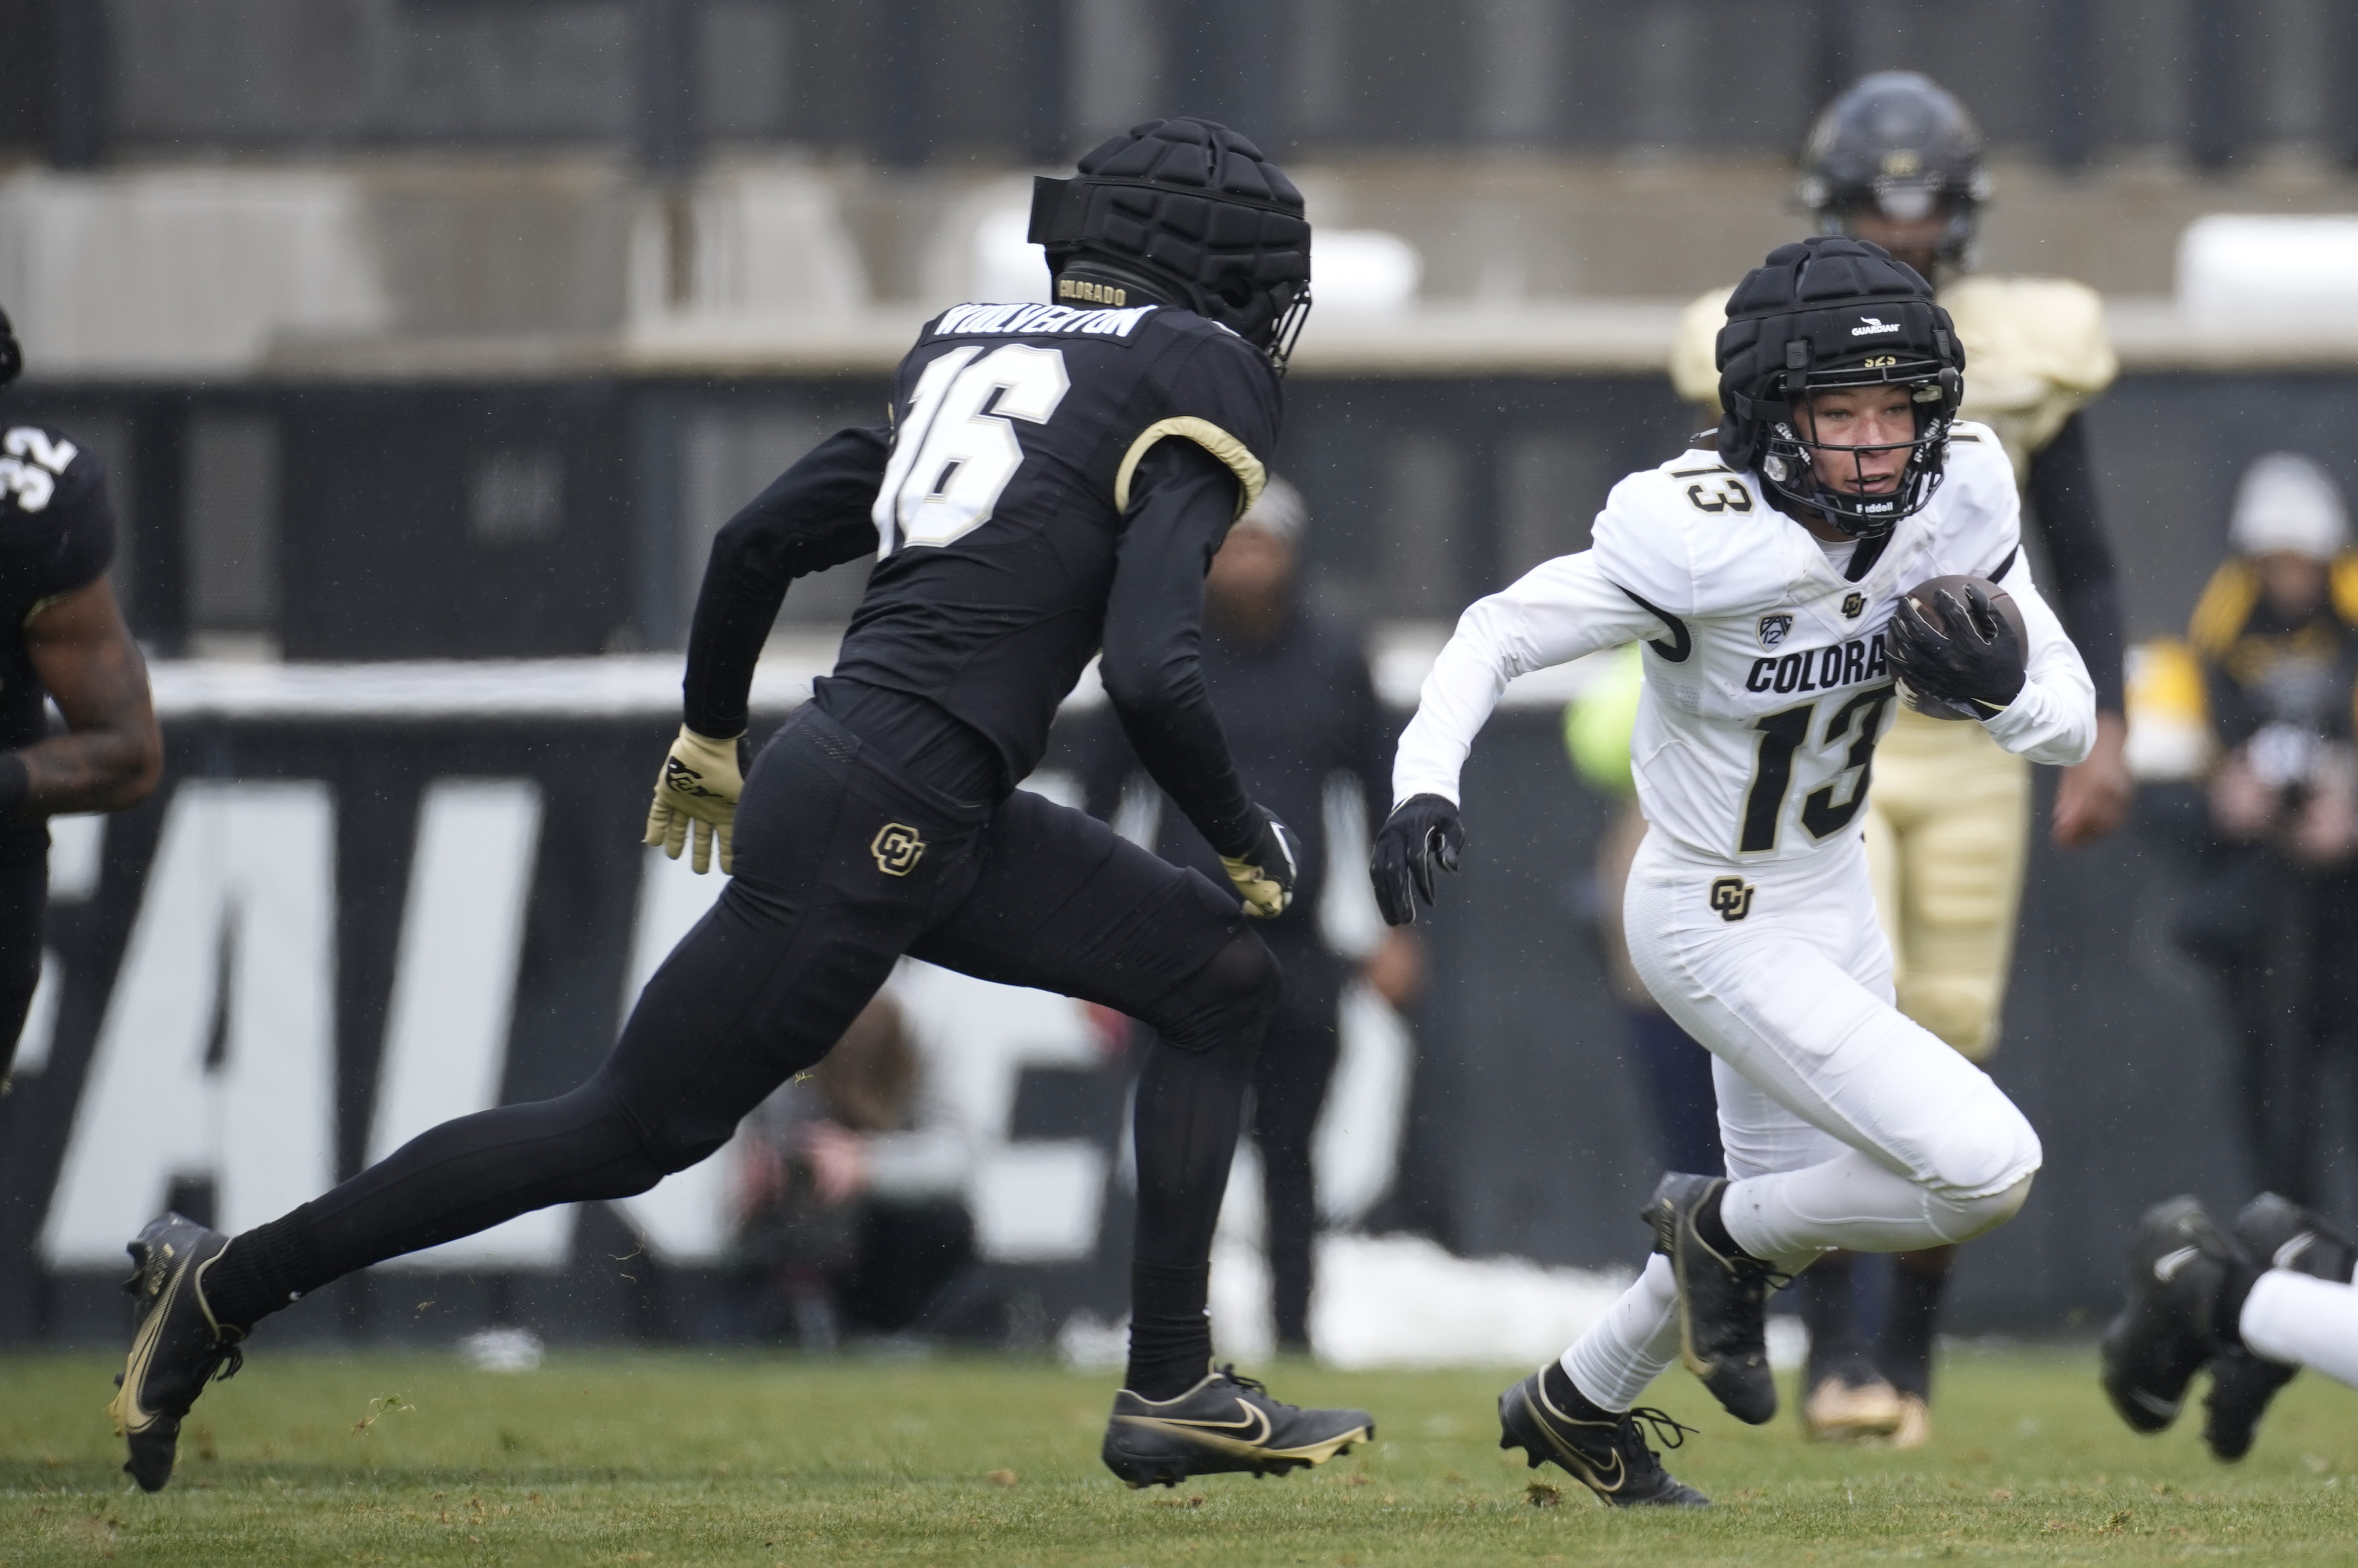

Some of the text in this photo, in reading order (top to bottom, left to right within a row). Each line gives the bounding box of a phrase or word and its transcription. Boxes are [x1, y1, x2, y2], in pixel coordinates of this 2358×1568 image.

[1059, 280, 1126, 306] COLORADO
[1851, 324, 1901, 336] GUARDIAN
[872, 344, 1071, 561] 16
[1668, 464, 1754, 516] 13
[1762, 630, 1782, 644] 12
[1746, 633, 1888, 694] COLORA
[1736, 682, 1895, 856] 13
